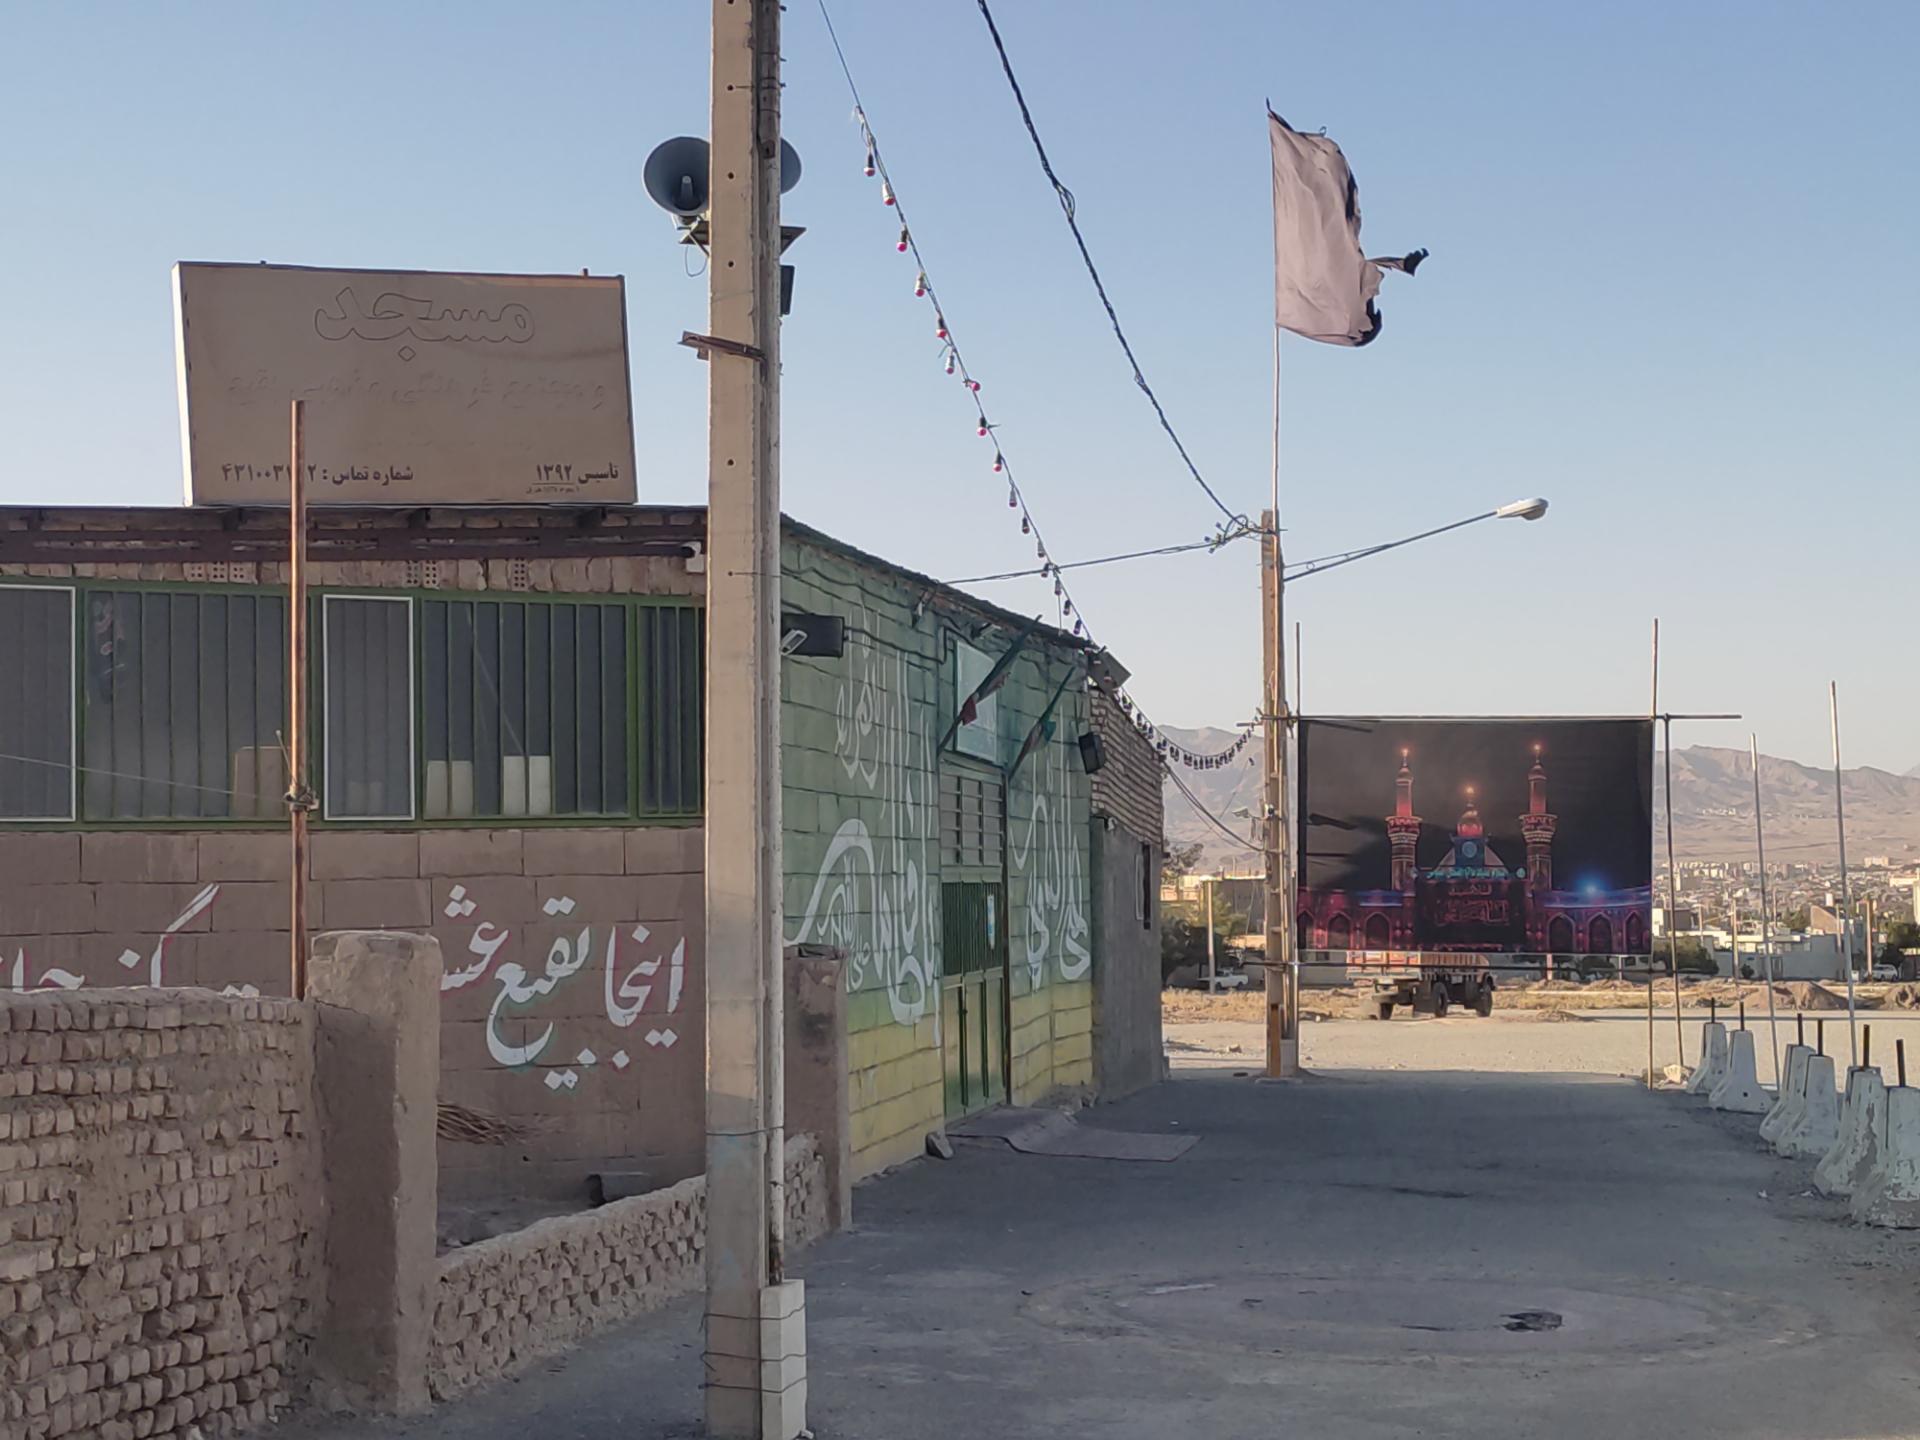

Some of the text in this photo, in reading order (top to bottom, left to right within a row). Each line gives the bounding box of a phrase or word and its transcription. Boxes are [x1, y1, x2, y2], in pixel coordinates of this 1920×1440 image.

[314, 286, 536, 362] مسجد
[372, 464, 414, 486] شماره
[536, 464, 573, 481] ۱۳۹۲
[440, 884, 509, 991] عش
[486, 896, 597, 1090] بقیع
[604, 924, 686, 1069] اینجا
